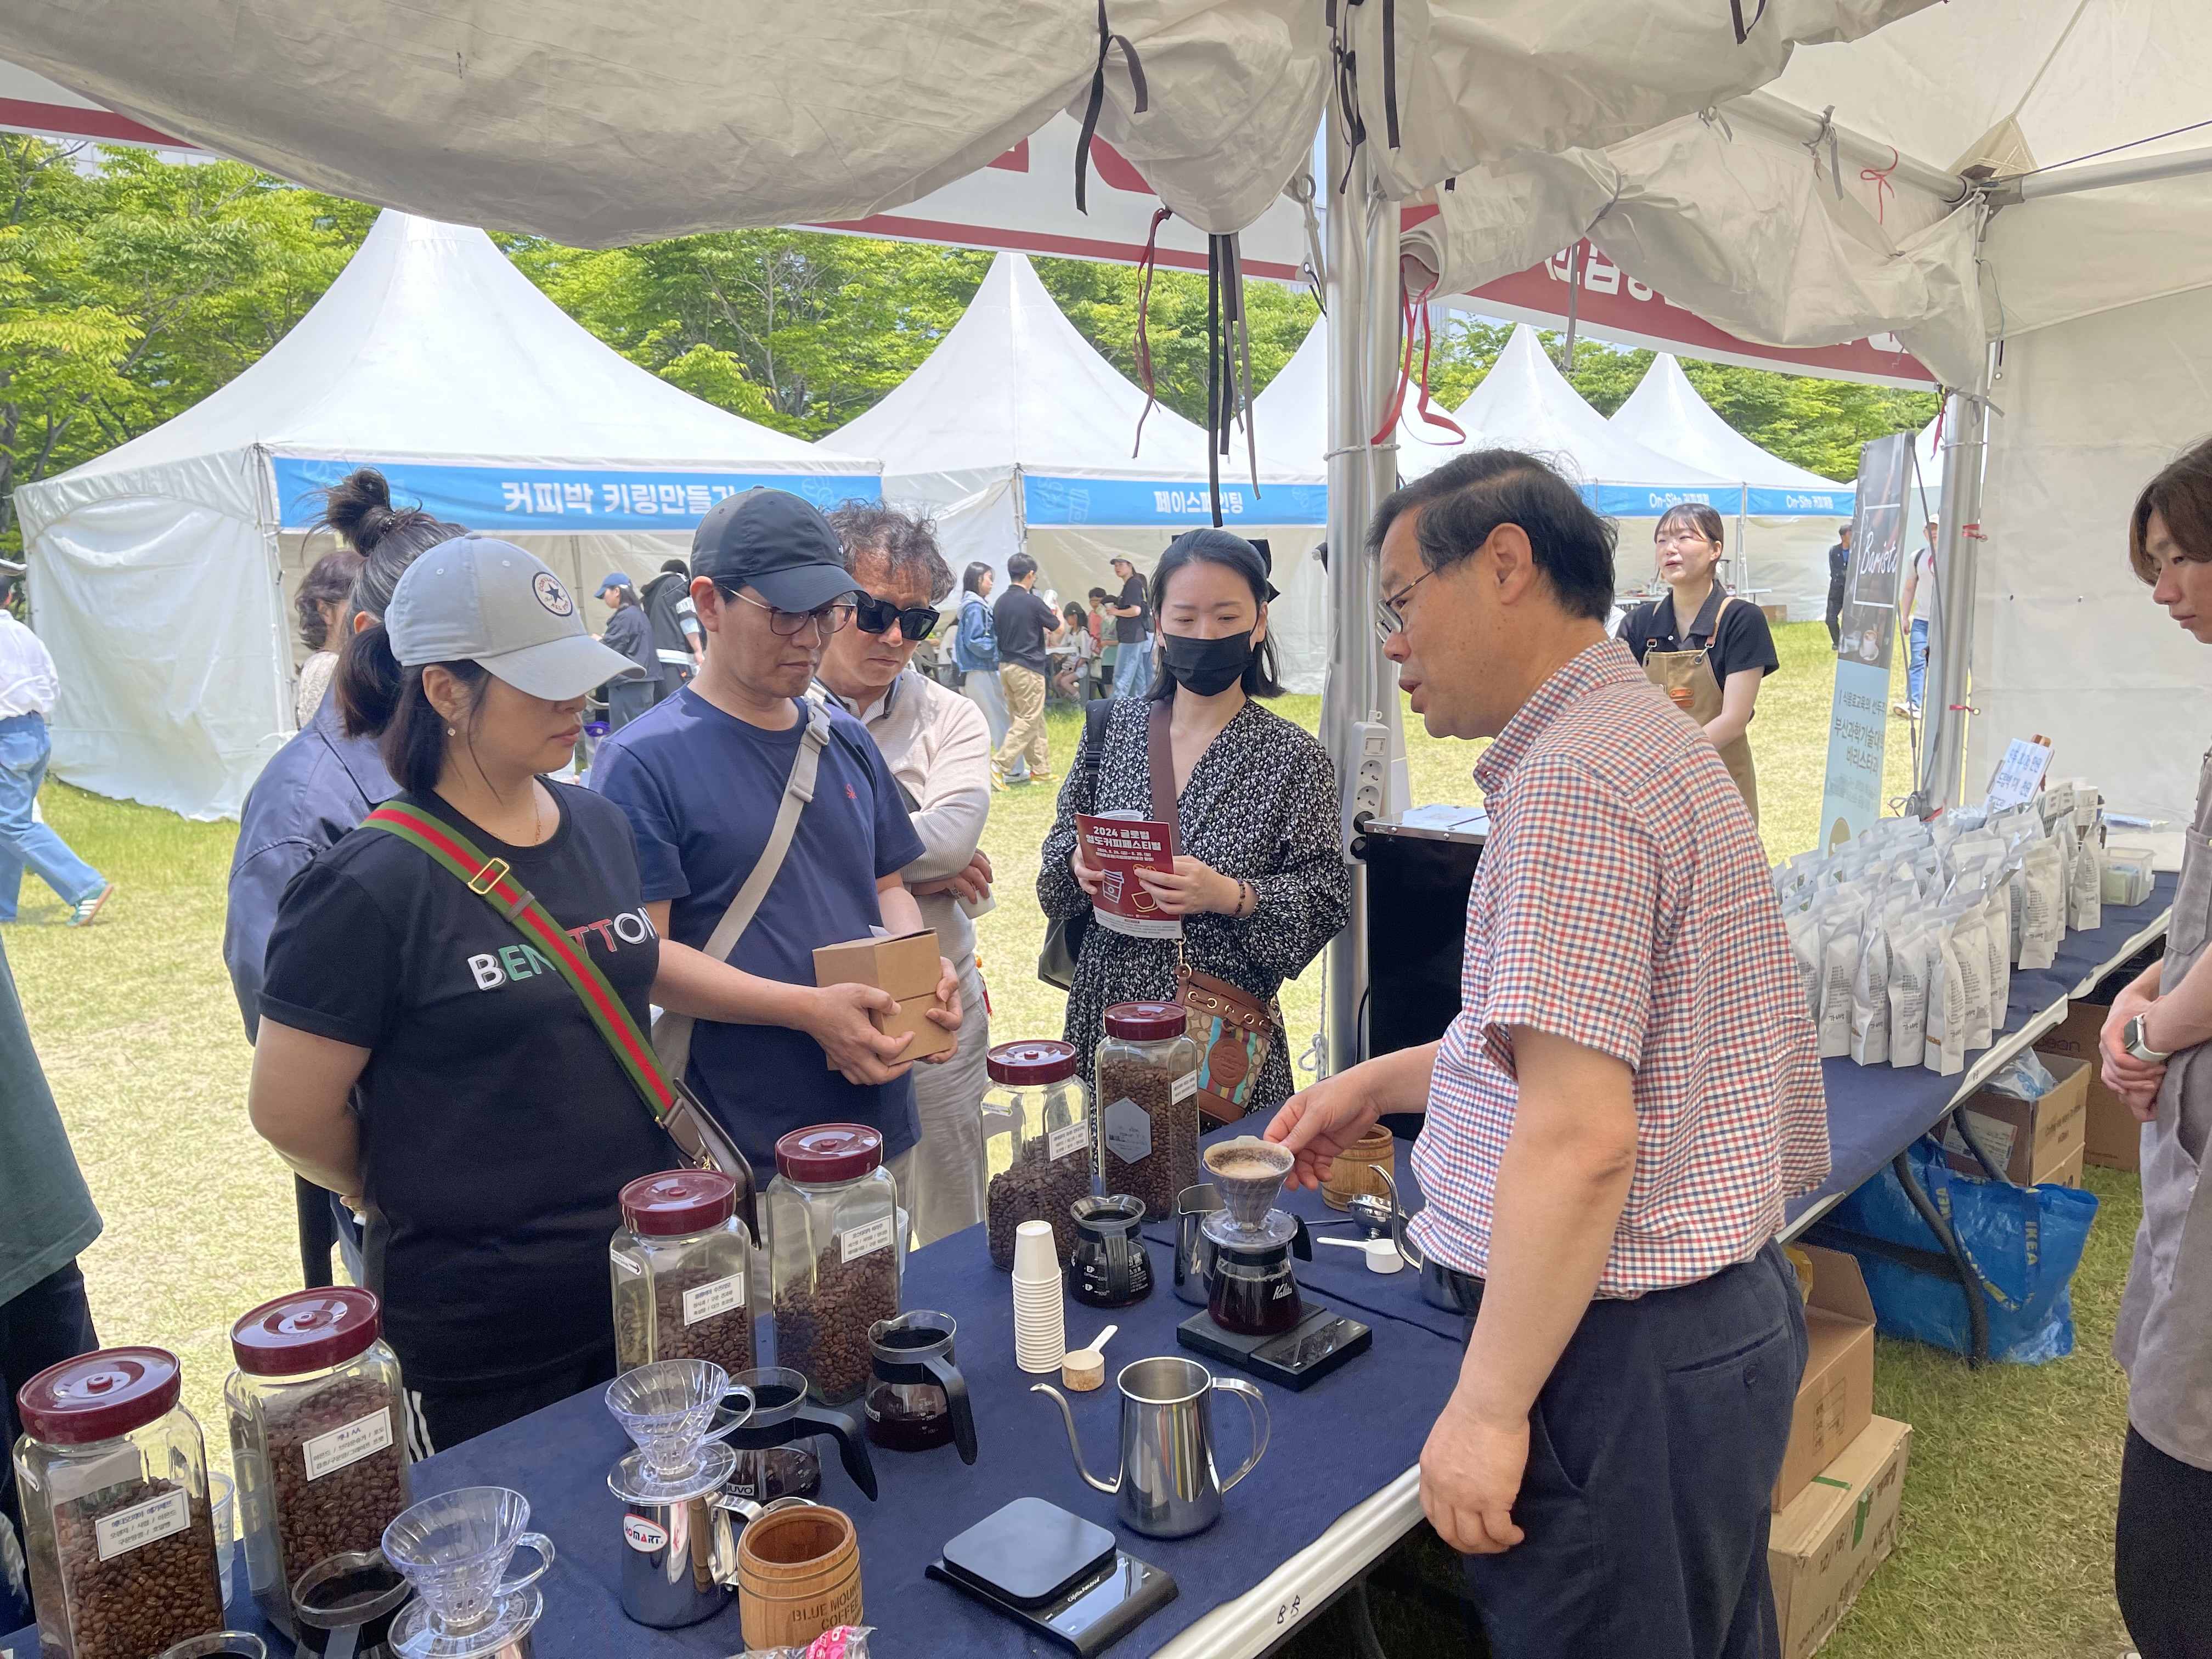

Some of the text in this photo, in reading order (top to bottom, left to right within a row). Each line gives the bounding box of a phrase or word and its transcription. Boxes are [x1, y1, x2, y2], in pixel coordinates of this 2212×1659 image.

[501, 482, 594, 514] 커피박
[1154, 490, 1244, 514] 페이스페인팅
[1860, 531, 1898, 575] Barista
[1847, 745, 1880, 777] 바리스타과
[1086, 834, 1161, 851] 영도커피페스티벌
[1093, 826, 1150, 840] 2024 글로벌
[467, 906, 659, 991] BENTTON
[1935, 1187, 1952, 1221] KEA
[2025, 1221, 2038, 1266] IKEA
[1272, 1283, 1293, 1300] Kalita
[624, 1522, 661, 1545] HOMART
[792, 1601, 827, 1622] BLUE
[831, 1576, 861, 1612] MOUNT
[821, 1594, 859, 1630] COFFEE
